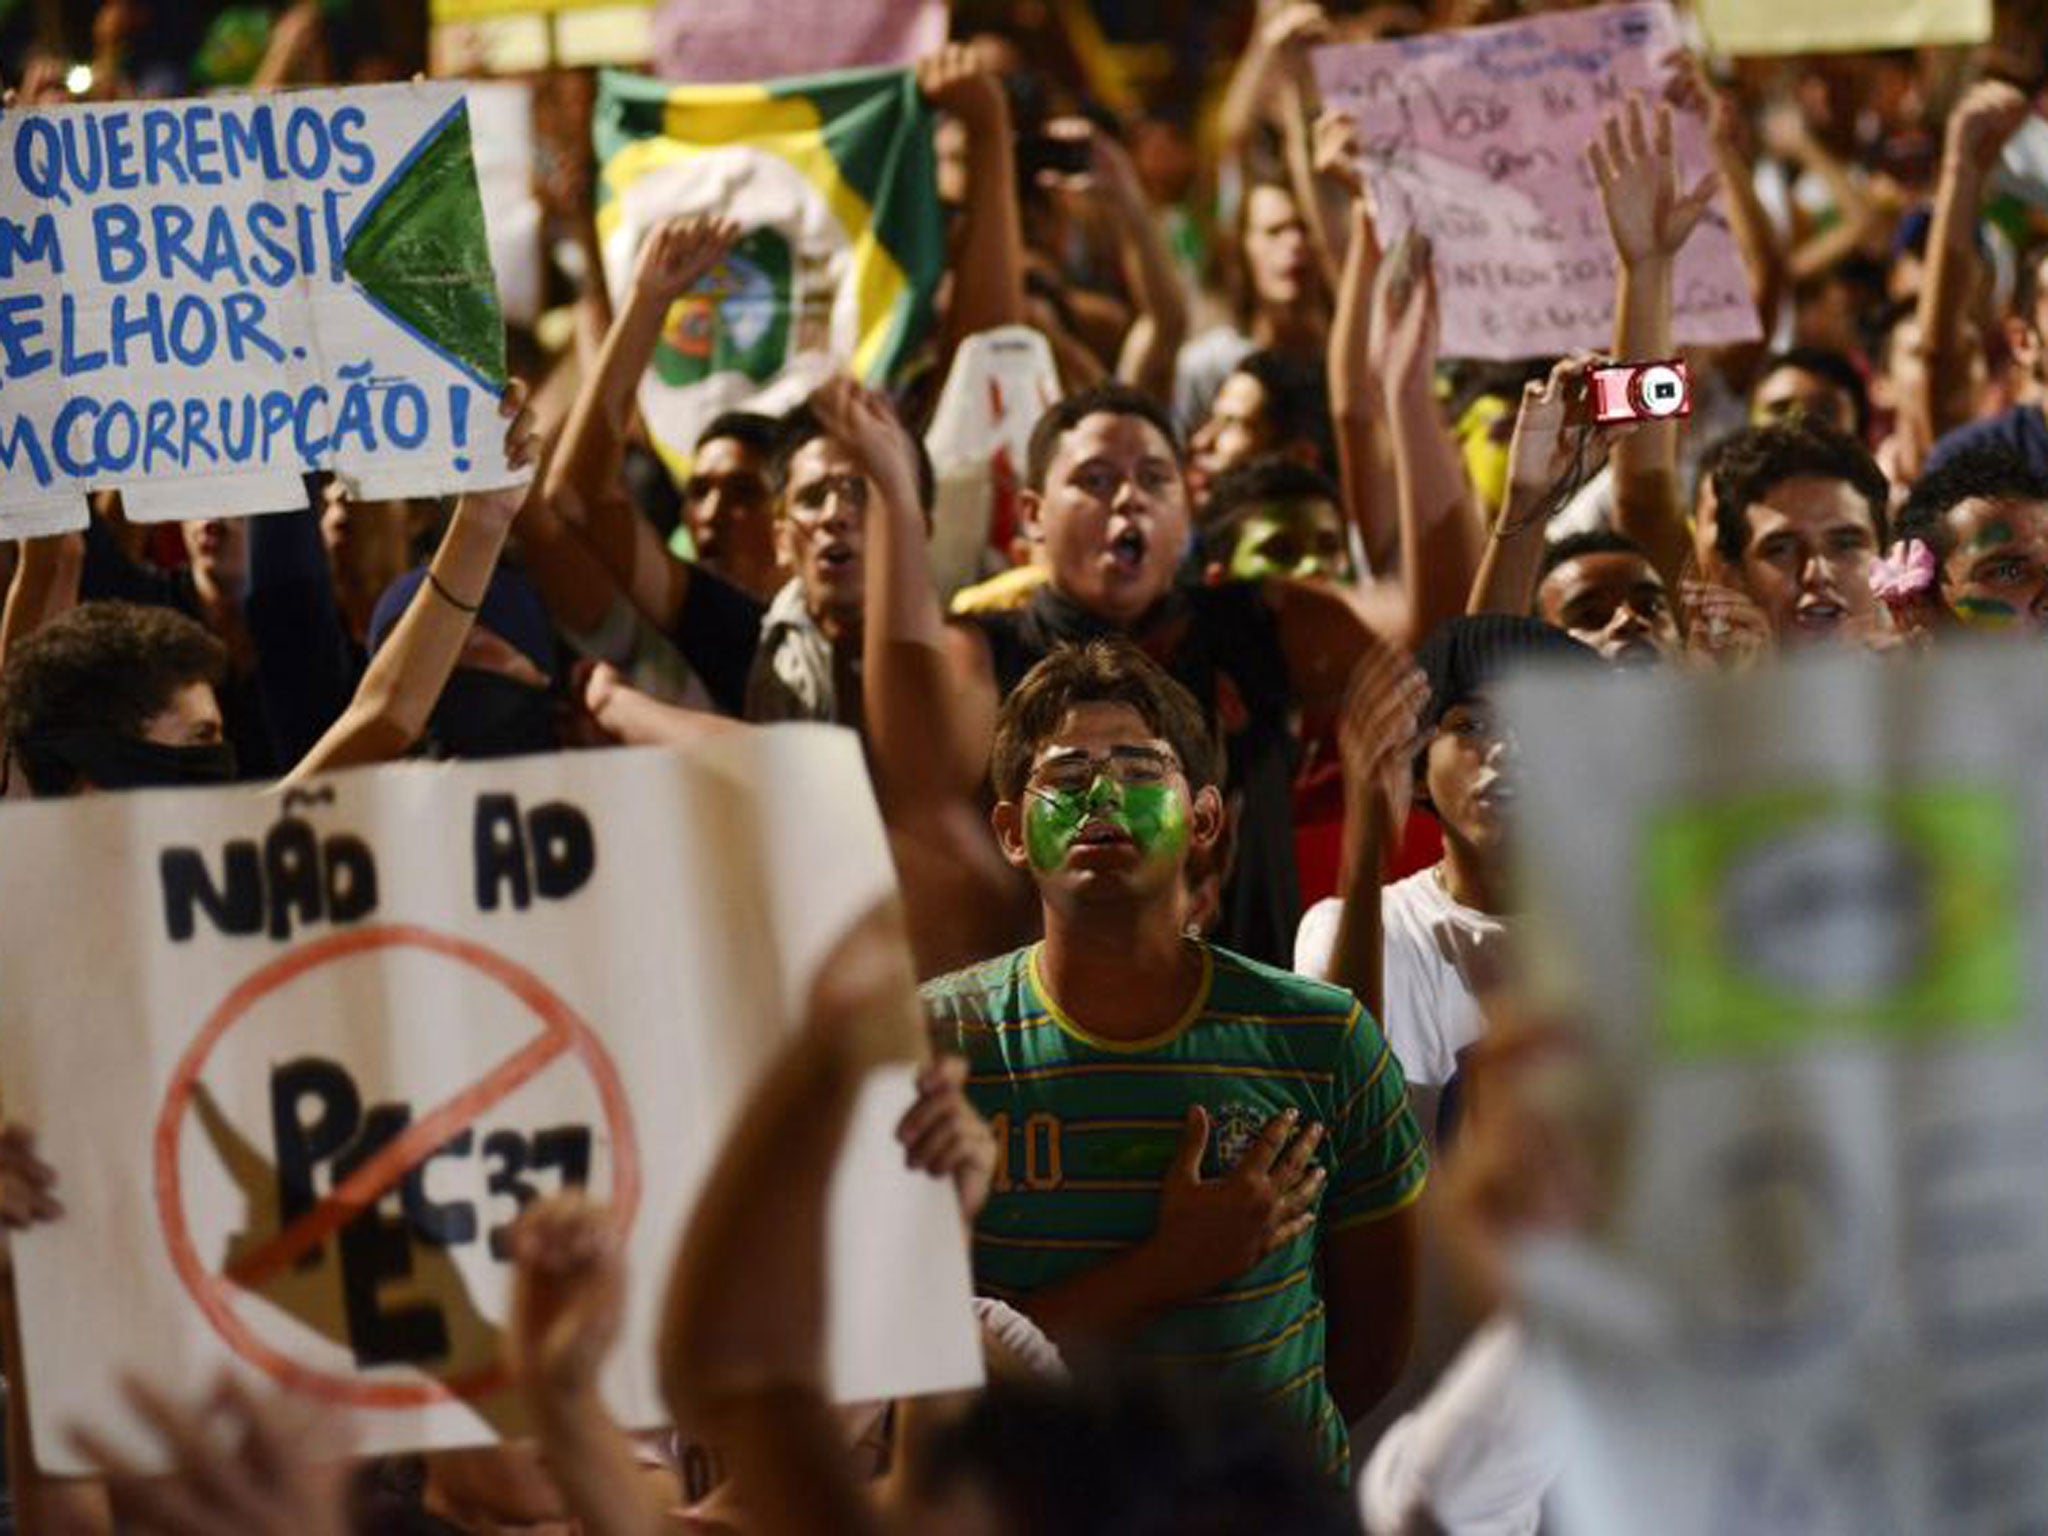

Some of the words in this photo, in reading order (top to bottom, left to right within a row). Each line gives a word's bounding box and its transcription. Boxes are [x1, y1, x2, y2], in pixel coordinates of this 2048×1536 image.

[14, 105, 376, 207] QUEREMOS
[0, 291, 307, 388] ELHOR.
[160, 786, 379, 942] NÃO
